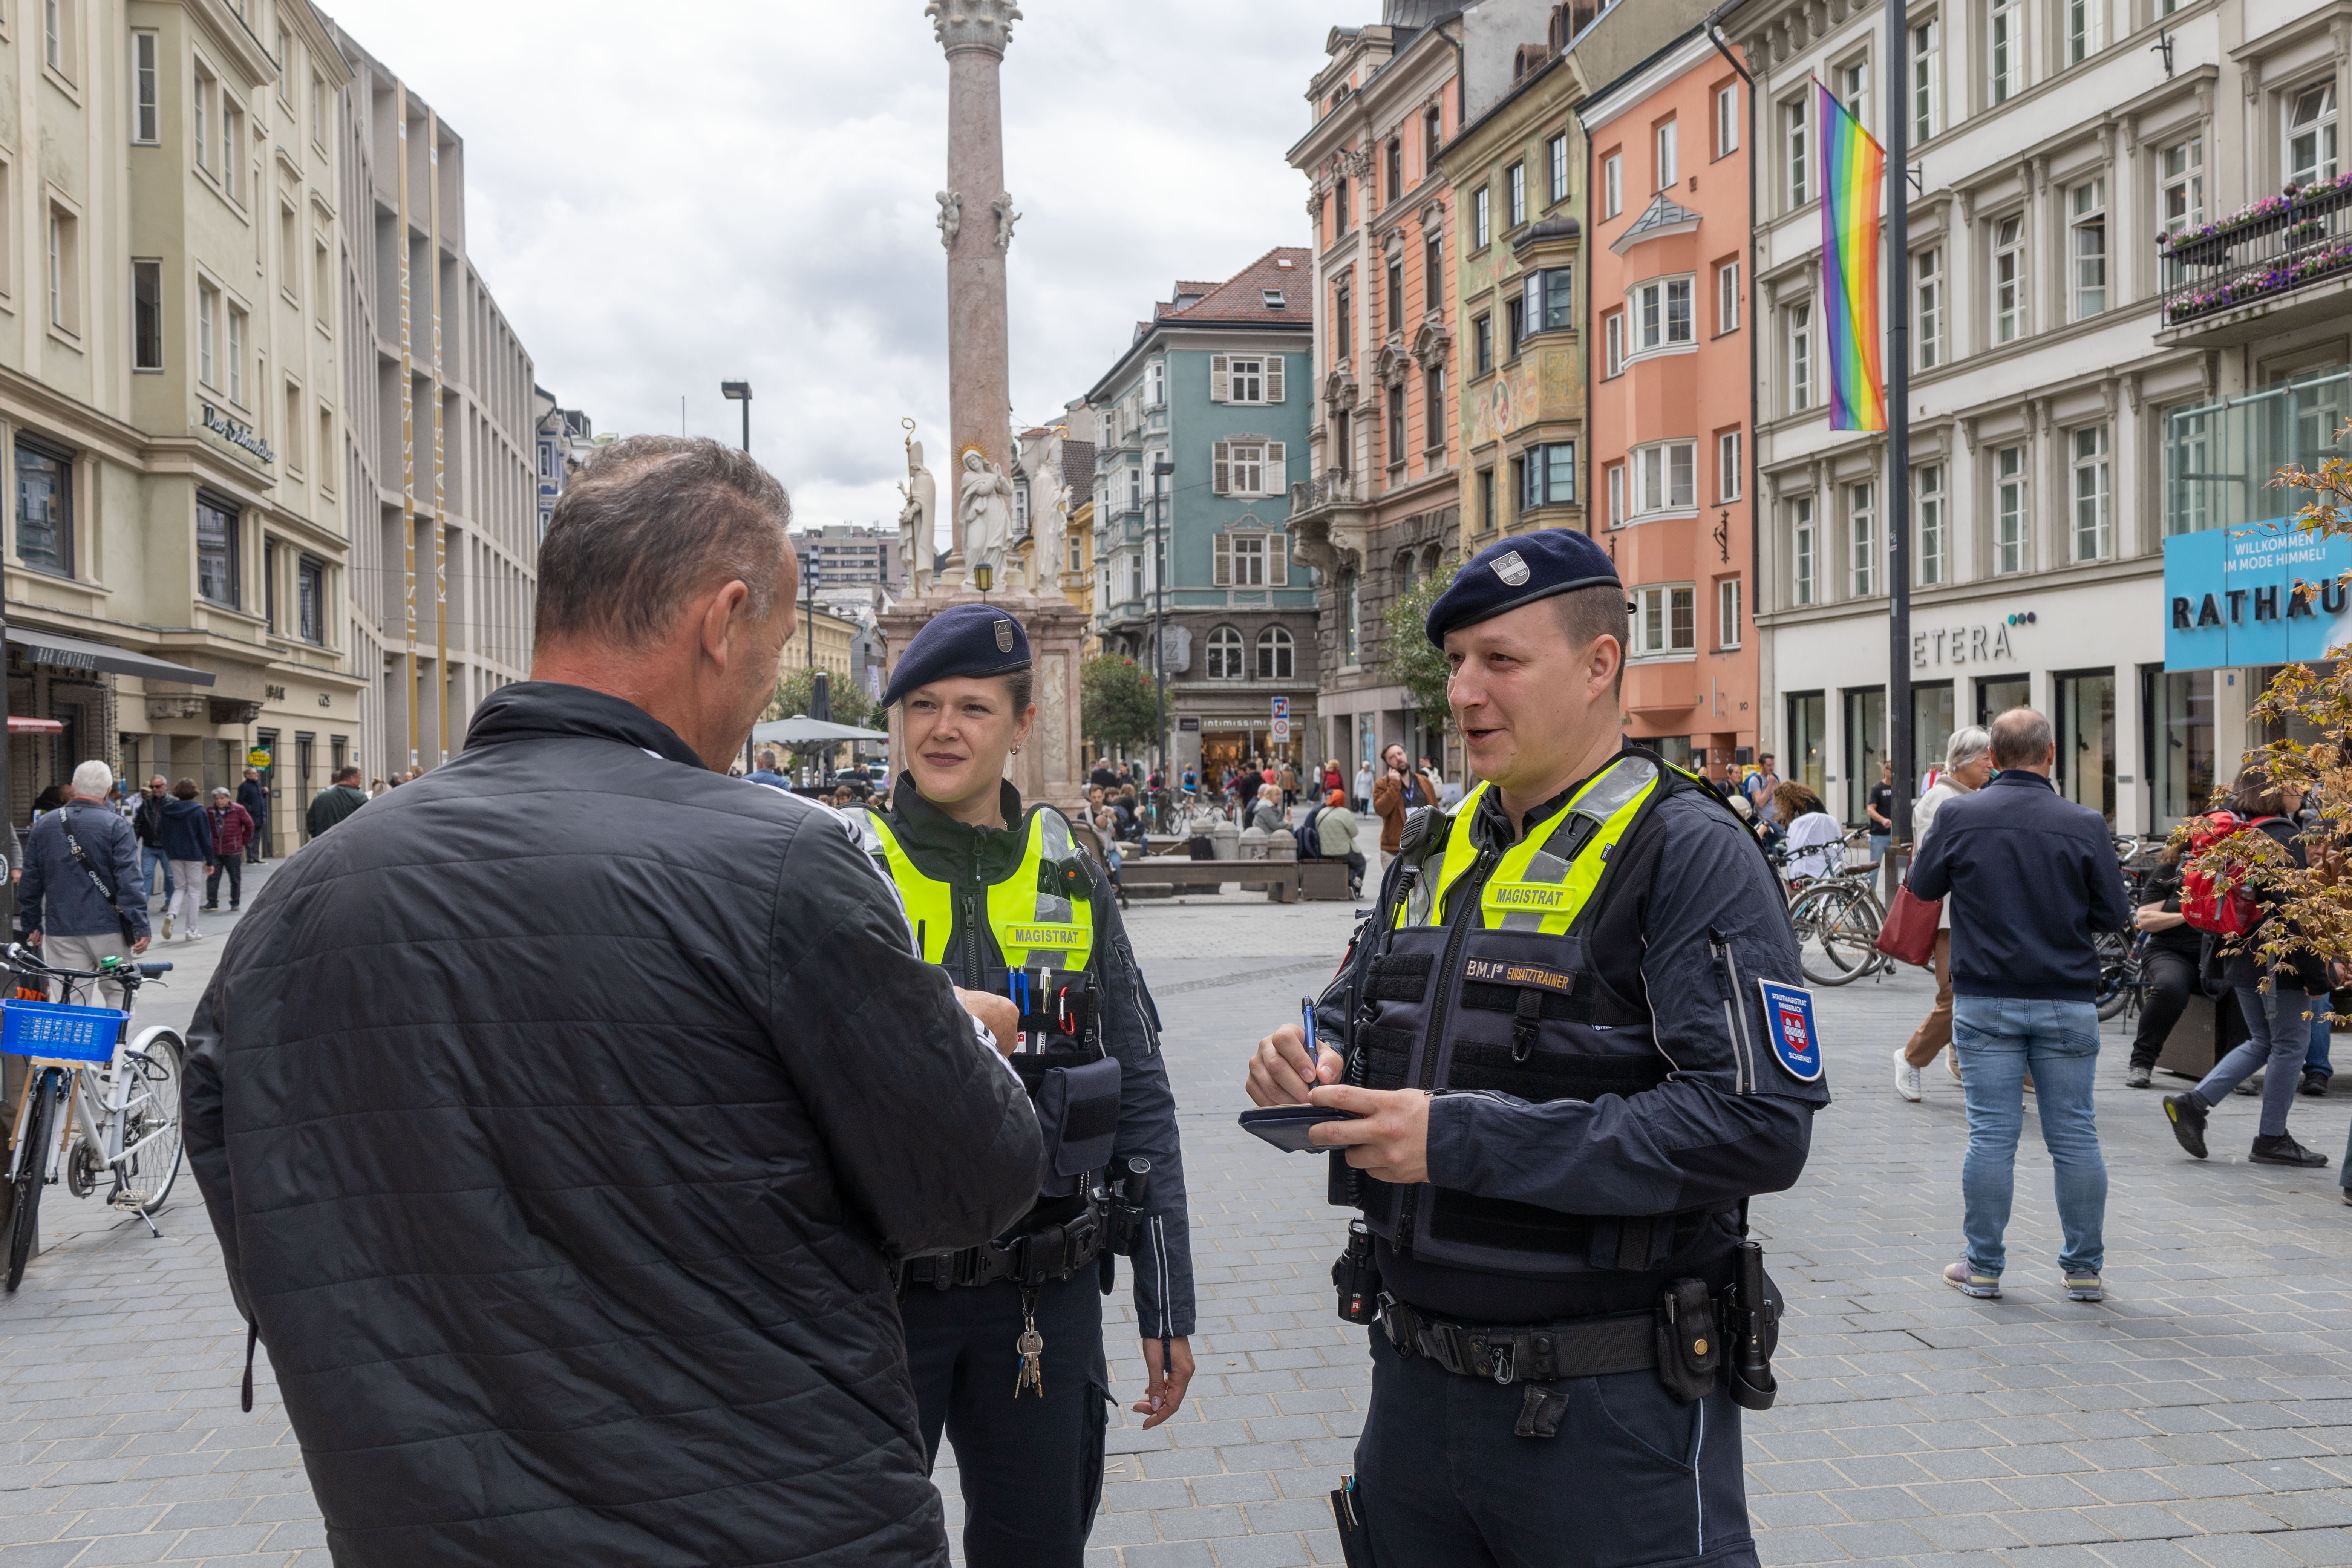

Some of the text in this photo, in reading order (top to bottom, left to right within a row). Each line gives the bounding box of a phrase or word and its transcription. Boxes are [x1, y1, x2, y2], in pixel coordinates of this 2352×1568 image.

[202, 404, 277, 463] Das Schindler
[2235, 533, 2314, 555] WILLKOMMEN
[2224, 547, 2326, 572] IM MODE HIMMEL!
[37, 648, 54, 663] BAR
[57, 650, 96, 669] CENTRALE
[1496, 888, 1564, 906] MAGISTRAT
[1015, 929, 1079, 944] MAGISTRAT
[1506, 967, 1569, 989] EINSATZTRAINER
[1772, 993, 1807, 1007] STADTMAGISTRAT
[1778, 1002, 1803, 1013] INNSBRUCK
[1788, 1052, 1812, 1064] SICHERHEIT
